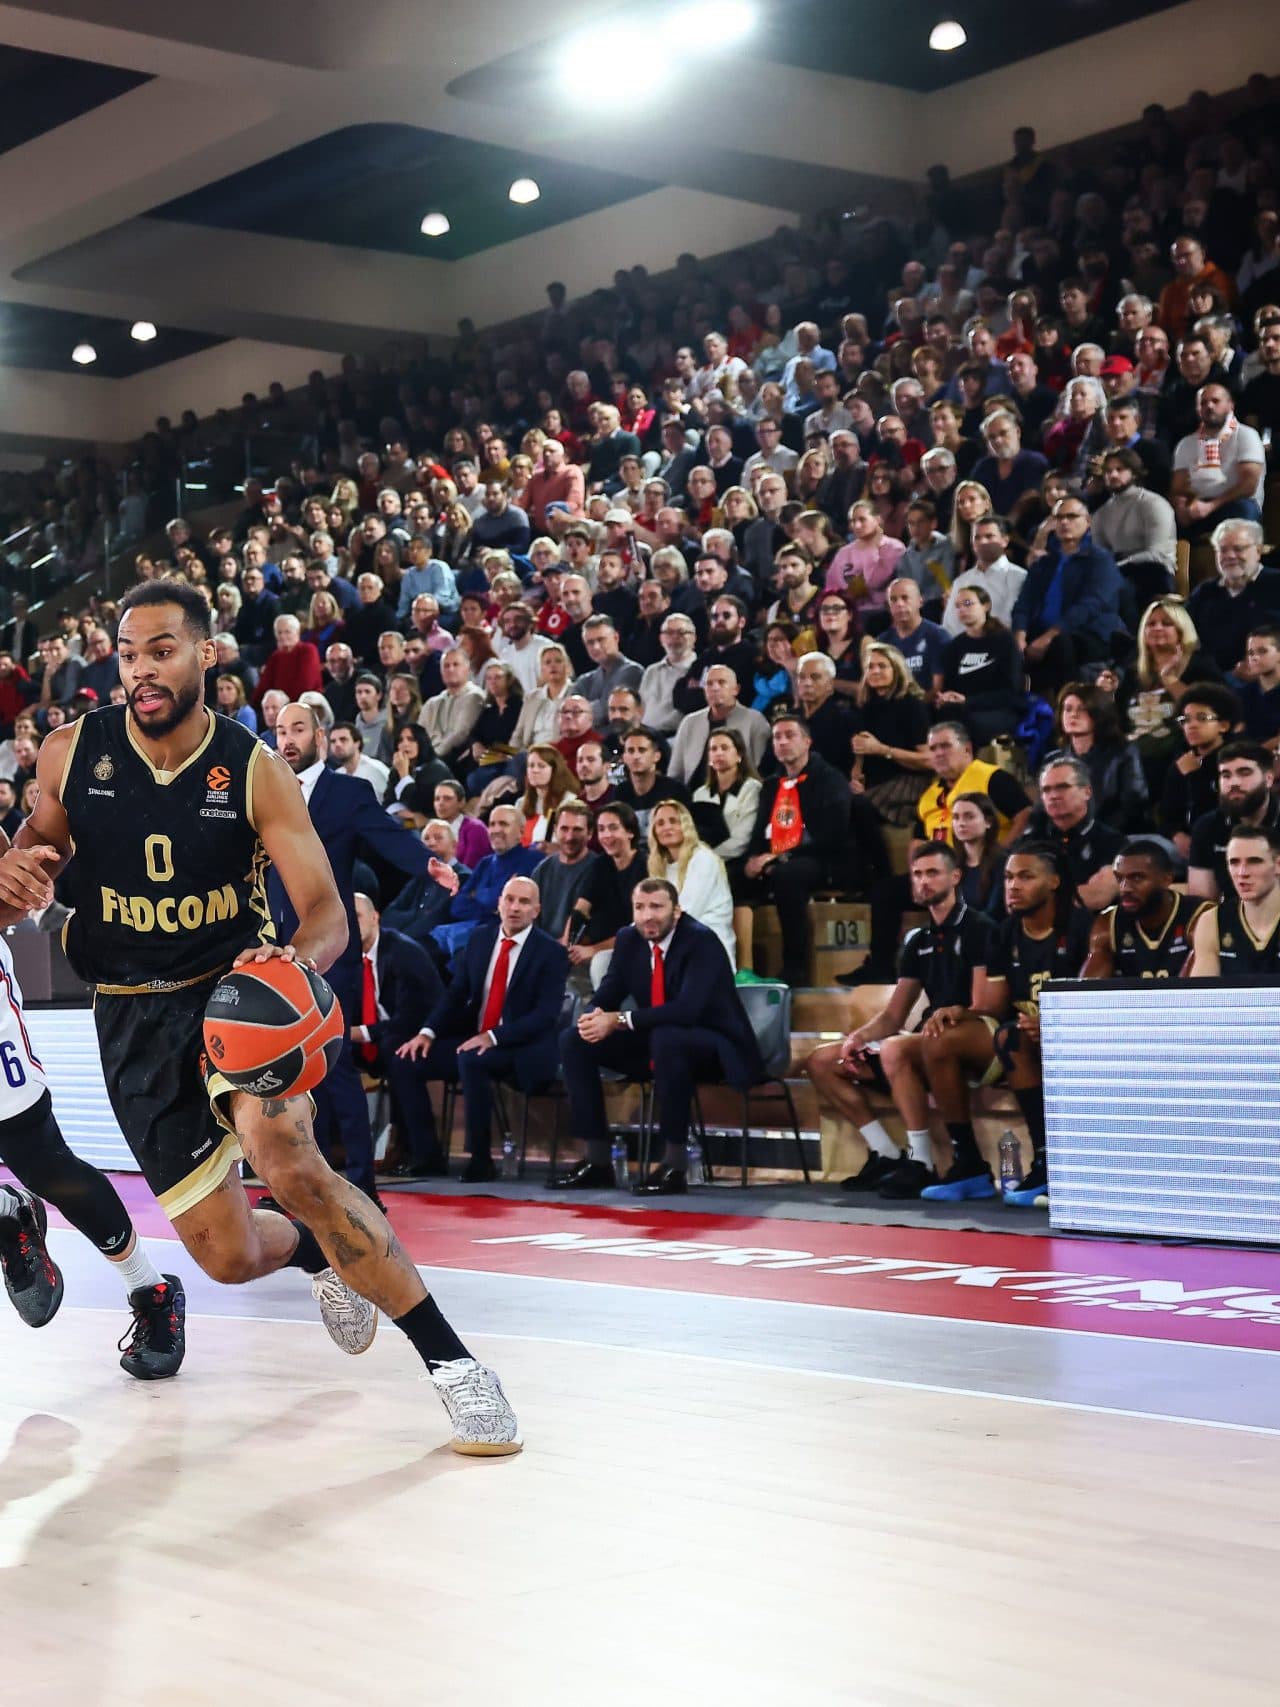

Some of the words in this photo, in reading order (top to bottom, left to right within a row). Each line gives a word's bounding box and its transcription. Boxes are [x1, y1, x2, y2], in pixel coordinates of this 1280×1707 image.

[144, 833, 175, 882] 0
[100, 883, 240, 933] FEDCOM
[835, 920, 859, 945] 03
